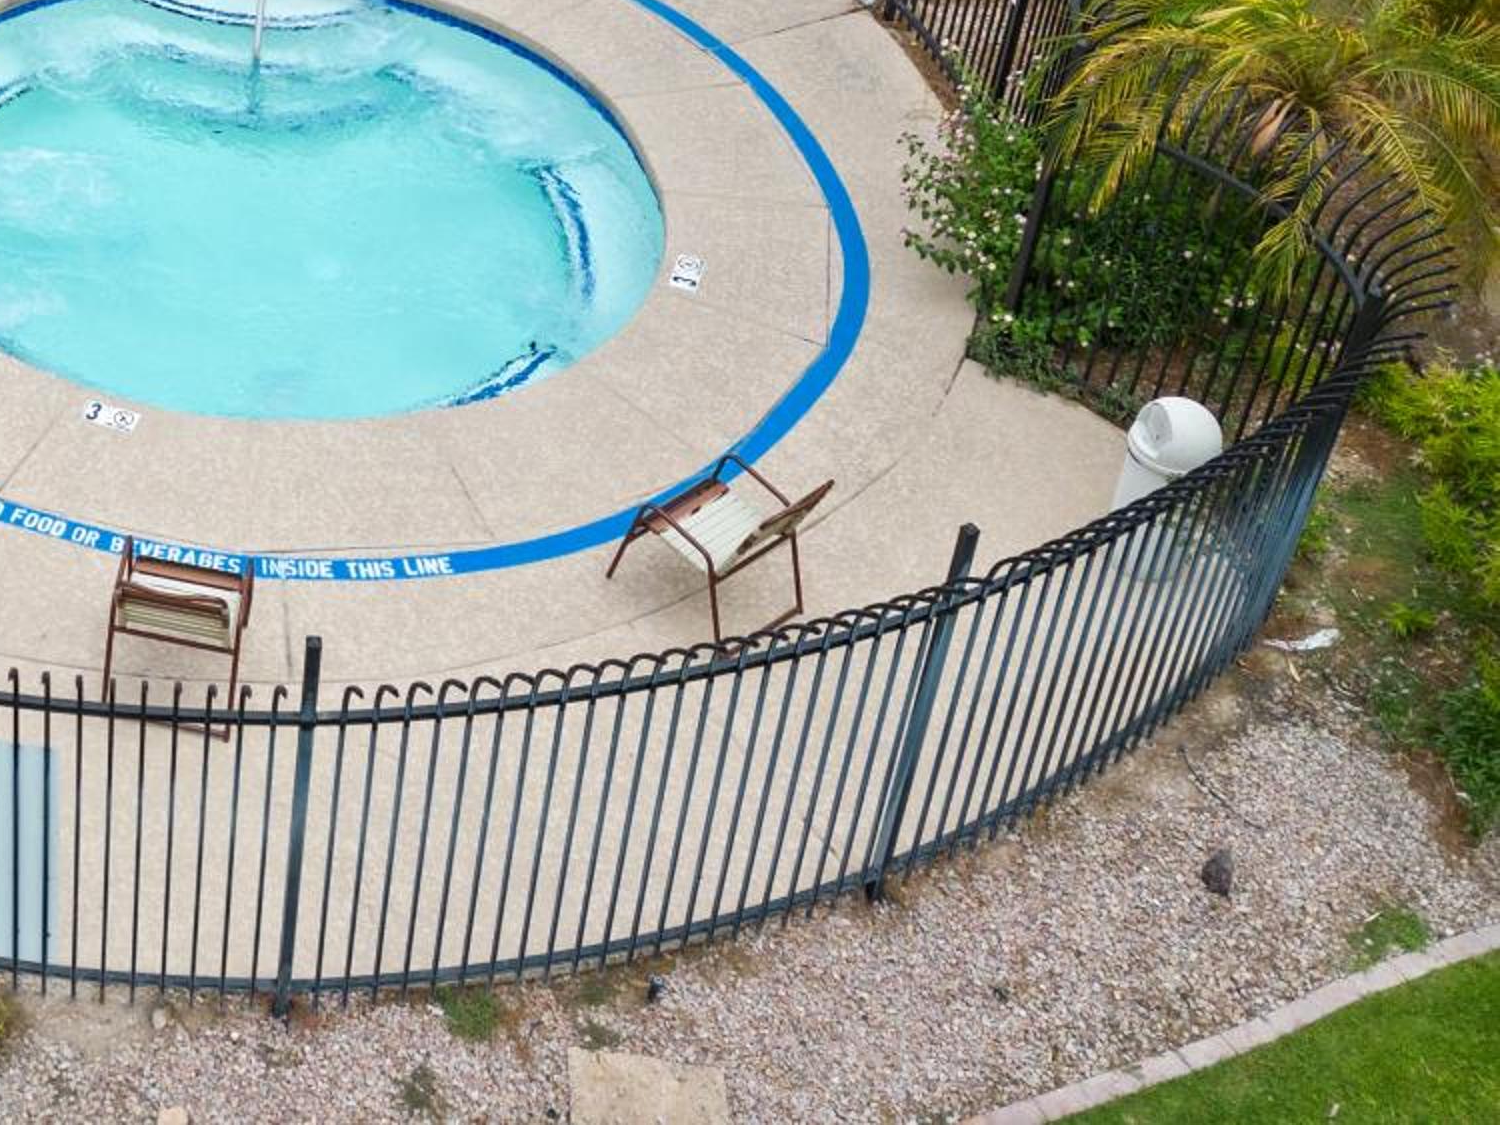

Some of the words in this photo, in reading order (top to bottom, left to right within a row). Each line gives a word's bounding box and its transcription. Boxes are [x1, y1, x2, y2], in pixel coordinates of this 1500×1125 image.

[85, 401, 103, 421] 3
[10, 507, 67, 537] FOOD
[71, 527, 101, 548] OR
[261, 557, 334, 578] INSIDE
[346, 560, 395, 578] THIS
[403, 556, 453, 577] LINE
